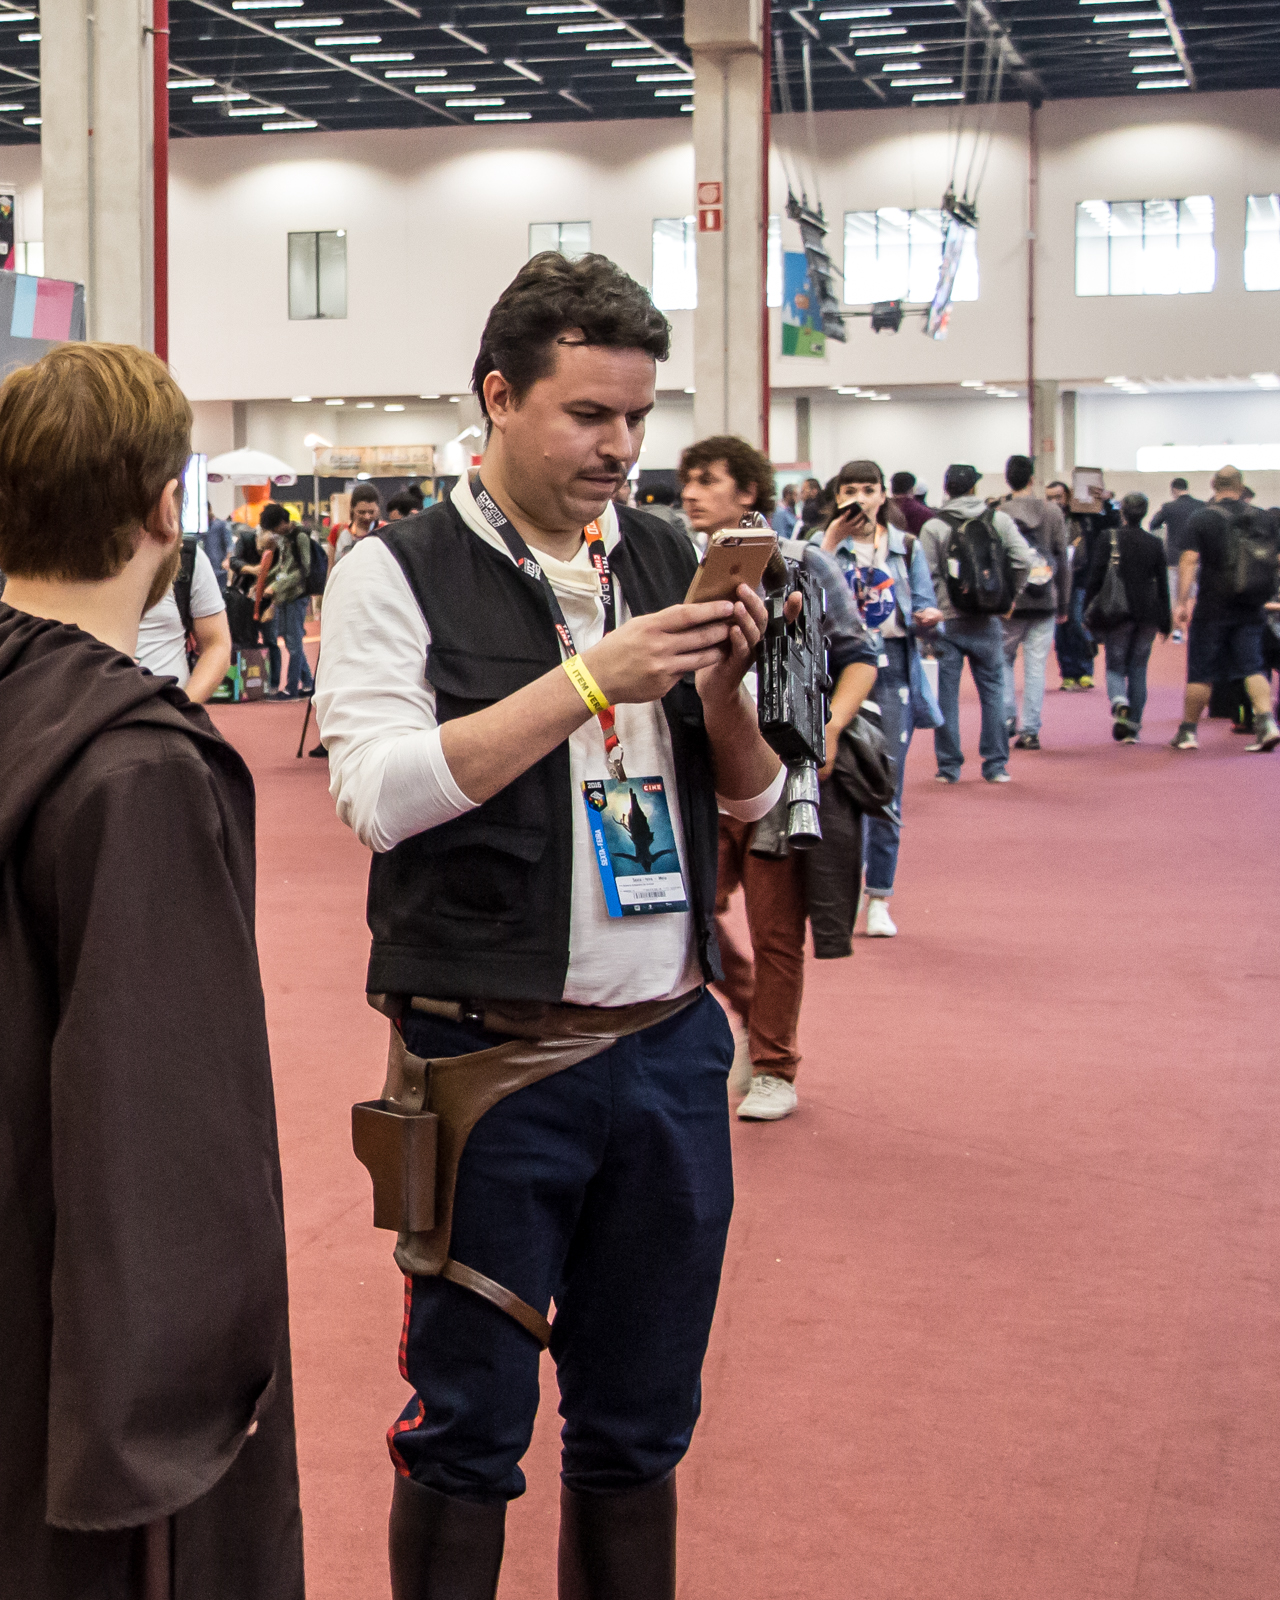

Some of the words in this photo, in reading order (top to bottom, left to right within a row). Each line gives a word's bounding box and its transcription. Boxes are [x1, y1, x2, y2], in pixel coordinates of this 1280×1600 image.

[478, 490, 507, 526] CCXP2016
[601, 556, 610, 574] TELE
[601, 583, 611, 606] PLAY
[572, 669, 588, 691] ITEM
